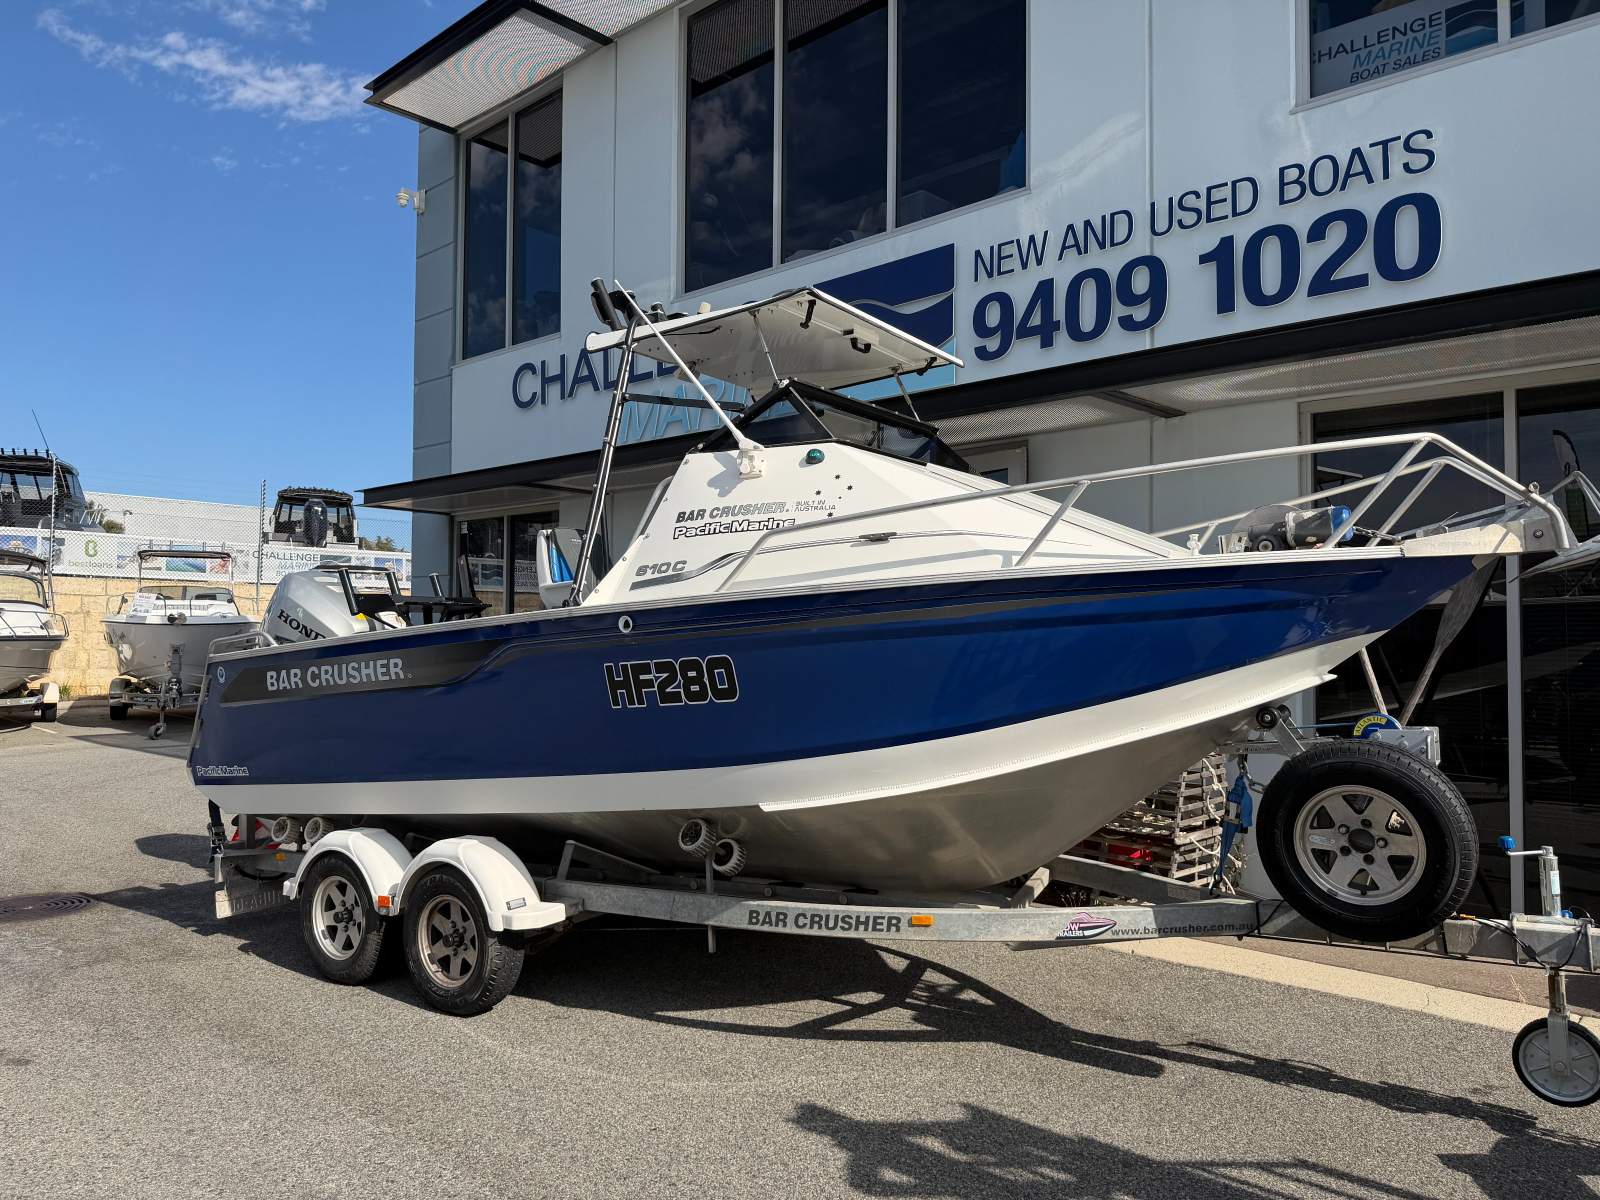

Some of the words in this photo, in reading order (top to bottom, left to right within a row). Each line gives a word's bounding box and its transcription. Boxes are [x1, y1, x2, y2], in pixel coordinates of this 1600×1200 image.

[1352, 28, 1442, 69] MARINE
[1350, 62, 1391, 84] BOAT
[1392, 47, 1441, 71] SALES
[973, 230, 1050, 283] NEW
[1058, 209, 1135, 262] AND
[1149, 176, 1259, 238] USED
[1278, 128, 1436, 206] BOATS
[972, 254, 1169, 362] 9409
[1198, 192, 1443, 315] 1020
[675, 508, 706, 523] BAR
[708, 501, 787, 519] CRUSHER
[794, 504, 836, 513] AUSTRALIA
[673, 521, 730, 540] Pacific
[730, 517, 795, 534] Marine
[252, 550, 319, 562] CHALLENGE
[266, 667, 303, 691] BAR
[306, 657, 404, 687] CRUSHER
[603, 654, 740, 709] HF280
[1354, 716, 1387, 736] ATLANTIC
[747, 909, 789, 929] BAR
[794, 911, 902, 933] CRUSHER
[1111, 922, 1254, 937] www.barcrusher.com.au
